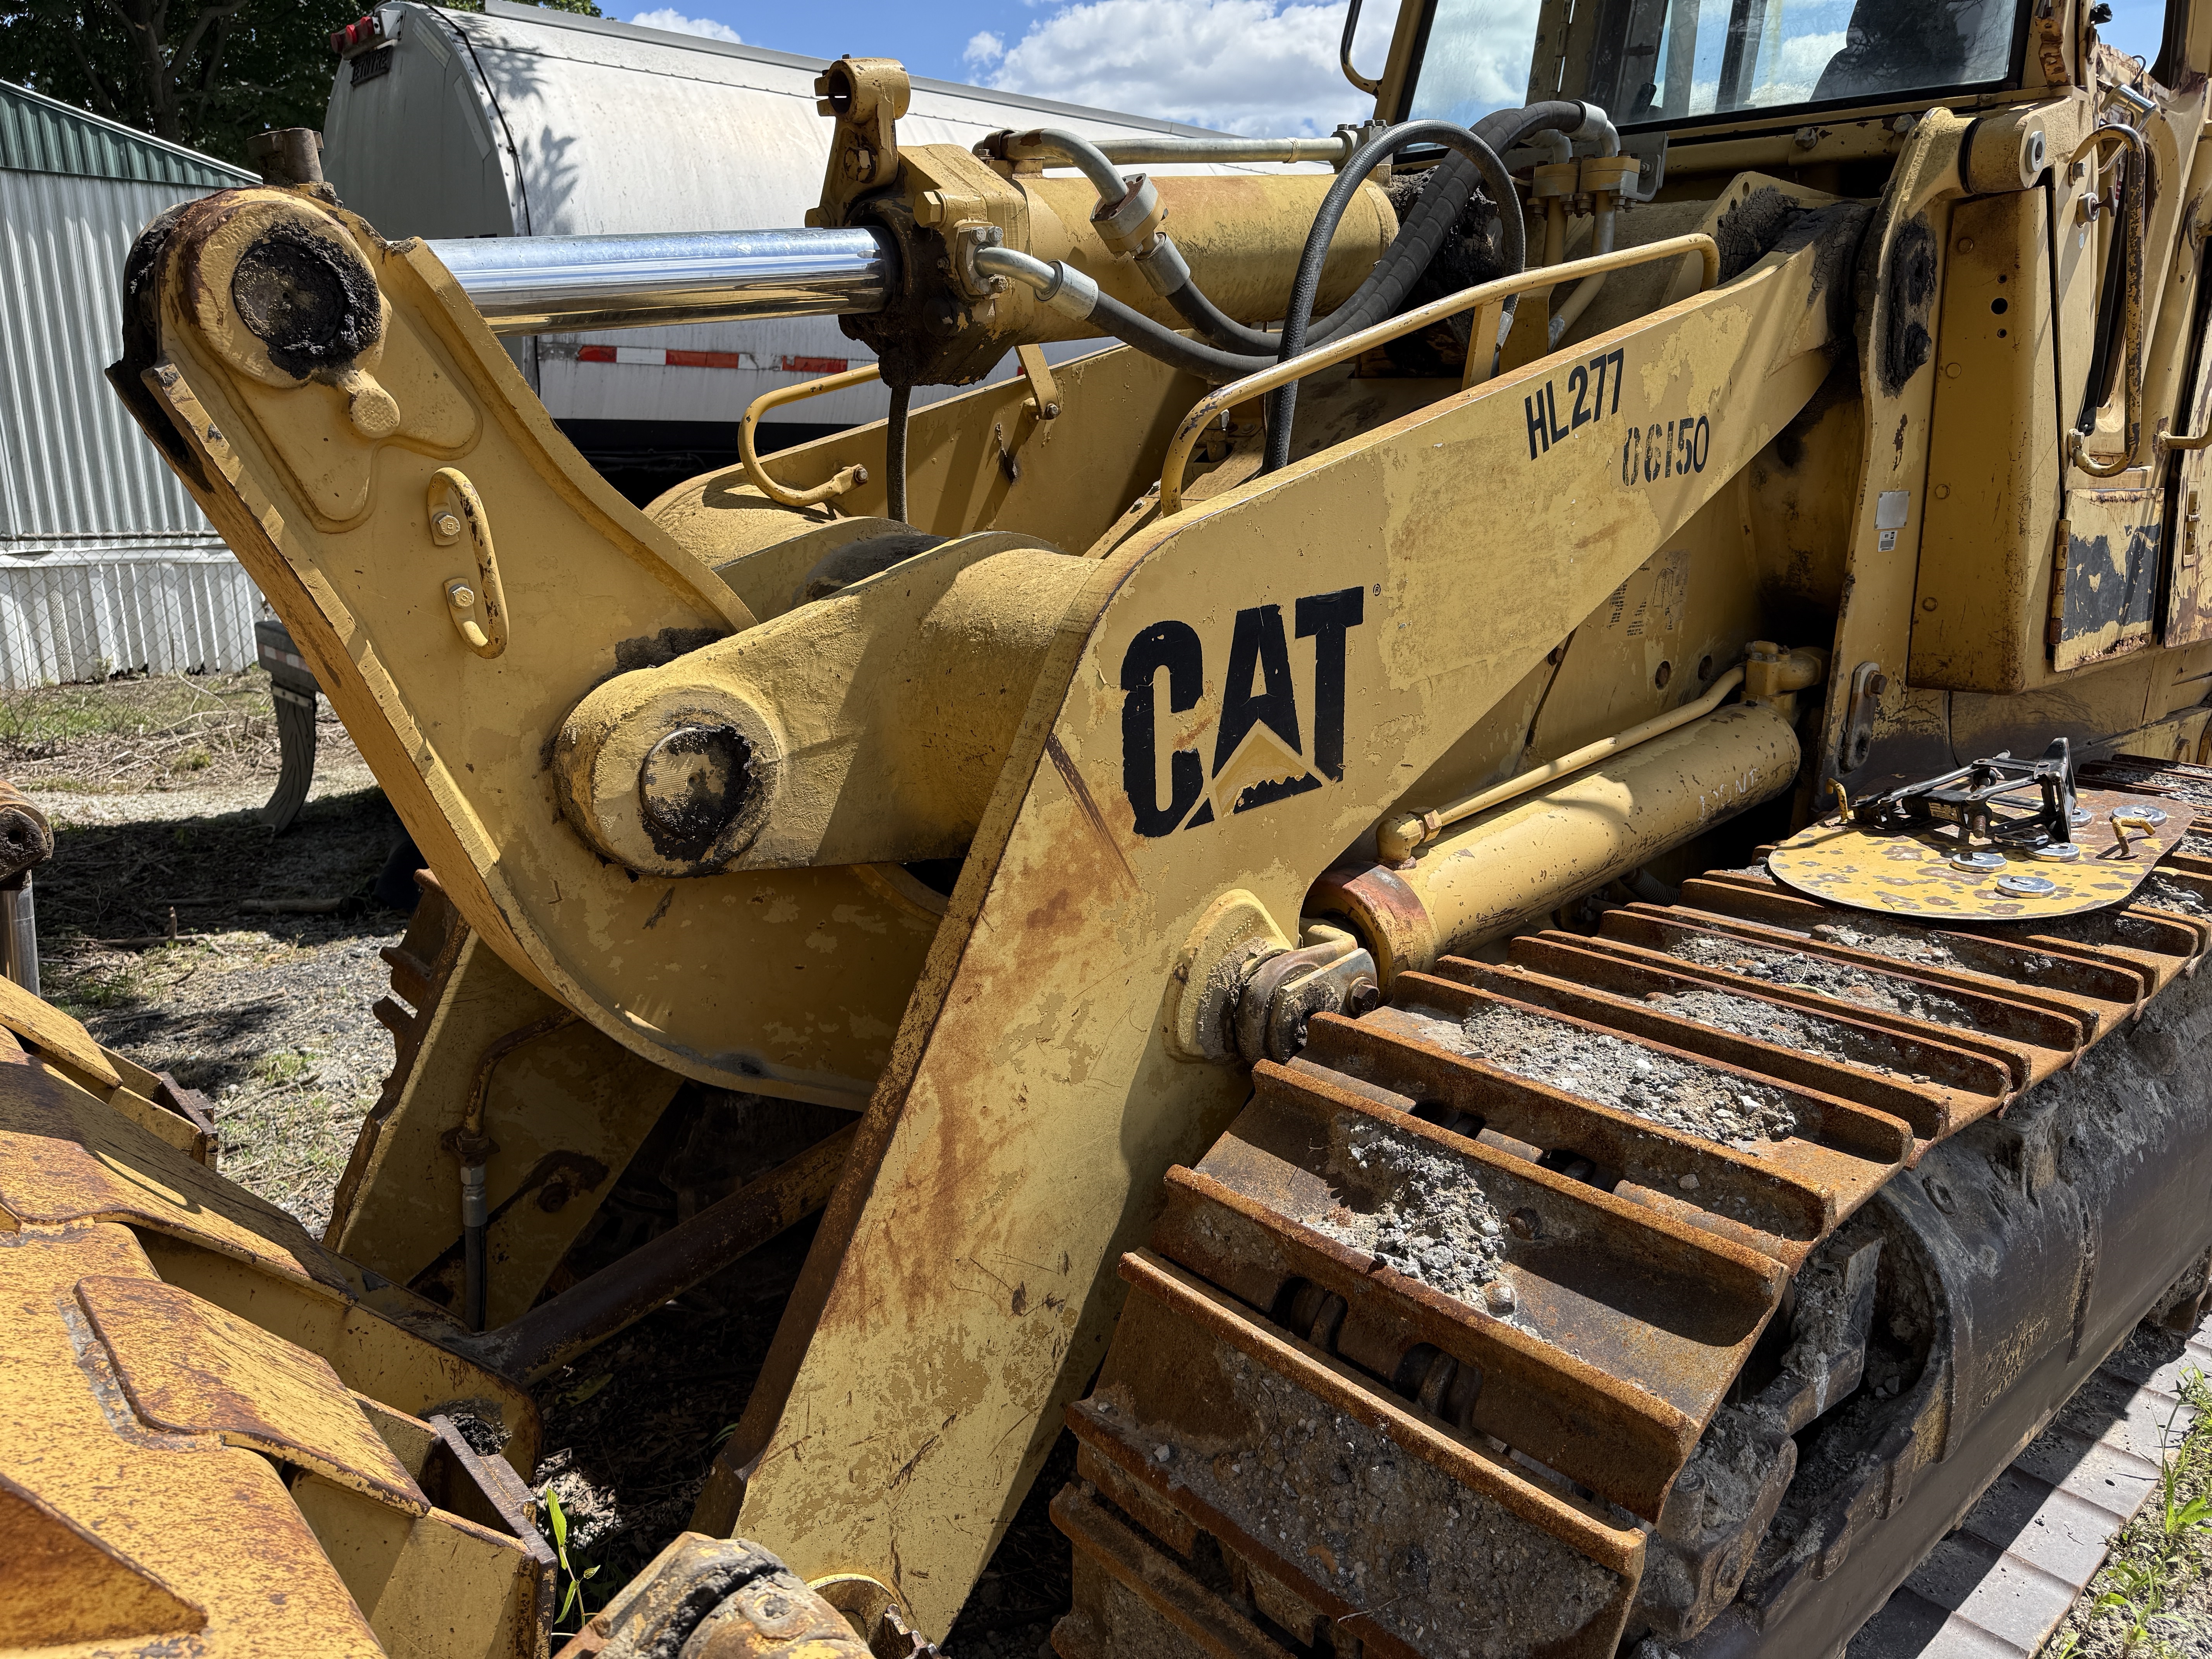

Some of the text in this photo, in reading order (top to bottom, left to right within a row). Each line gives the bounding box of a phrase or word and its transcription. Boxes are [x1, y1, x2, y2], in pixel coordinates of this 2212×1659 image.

[353, 51, 387, 80] ETNYRE
[1524, 347, 1624, 461] HL277
[1622, 415, 1710, 486] 06150
[1121, 586, 1364, 838] CAT
